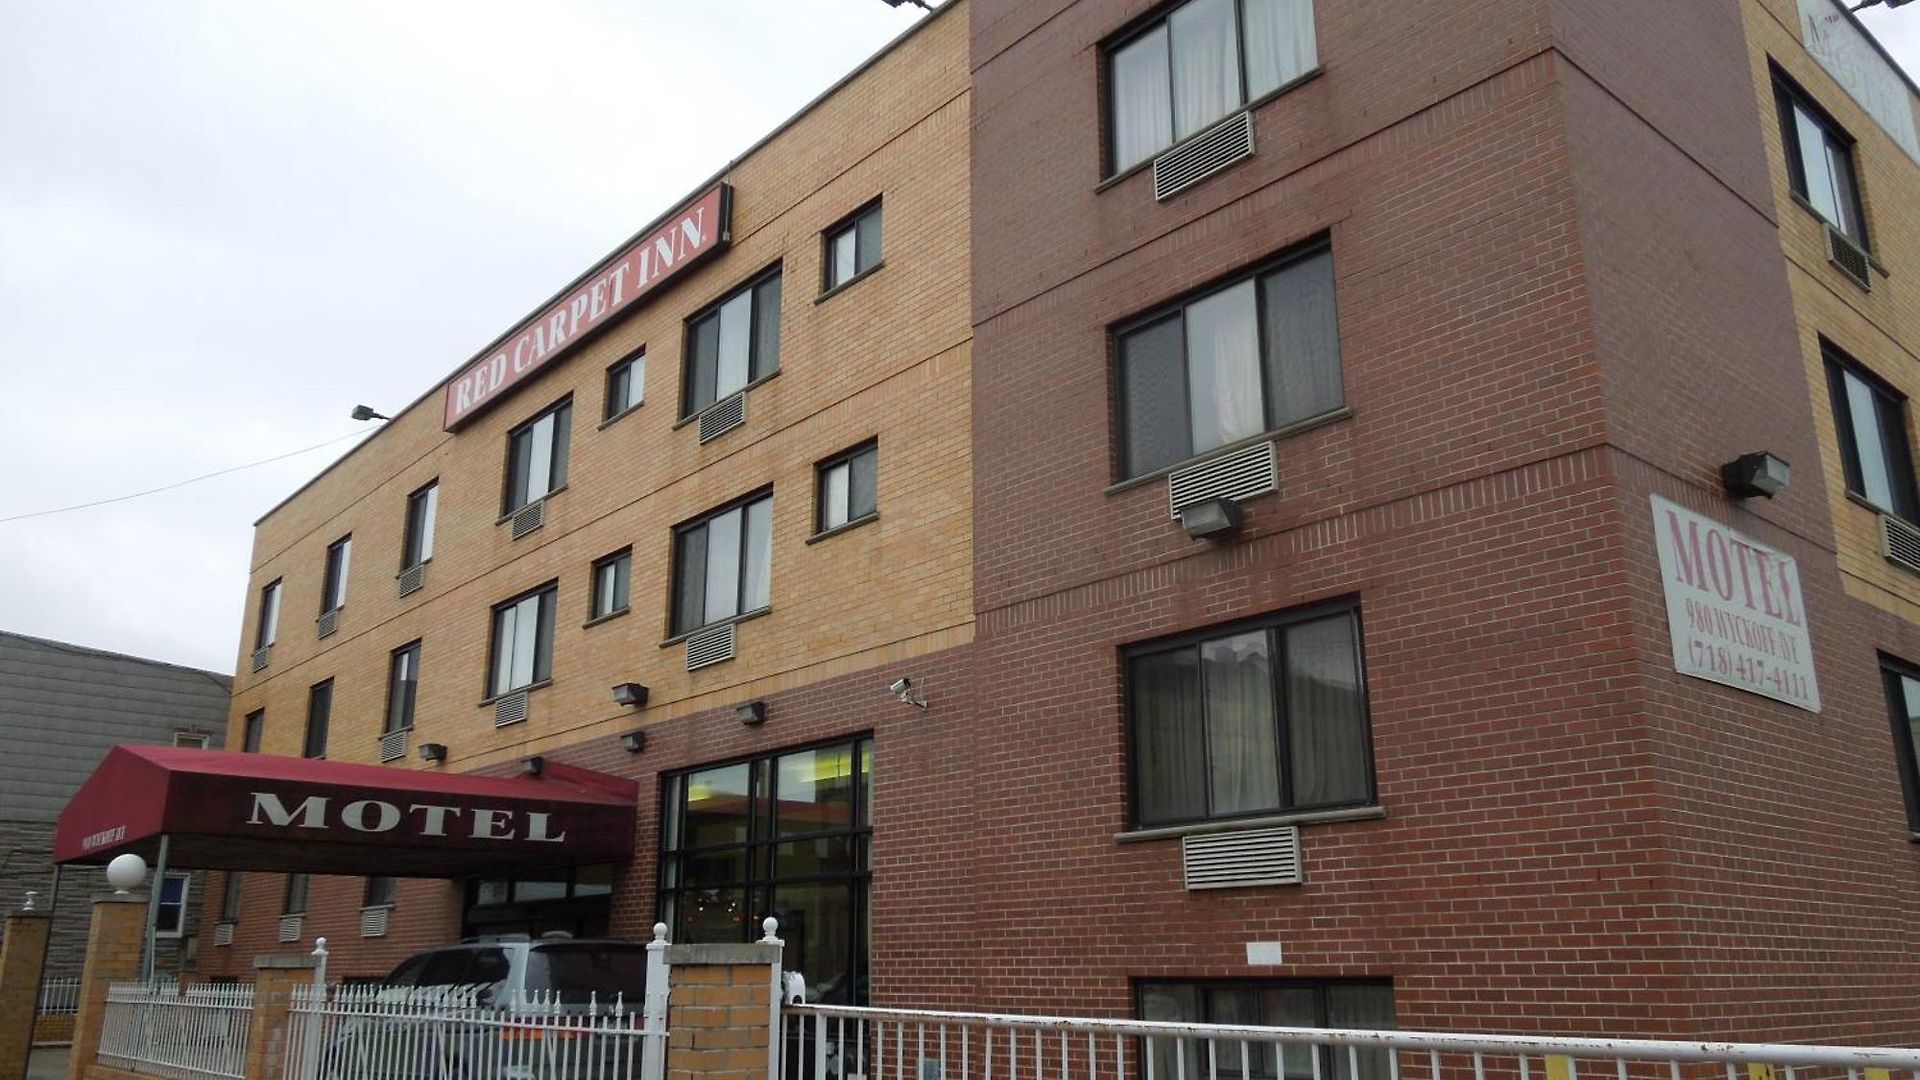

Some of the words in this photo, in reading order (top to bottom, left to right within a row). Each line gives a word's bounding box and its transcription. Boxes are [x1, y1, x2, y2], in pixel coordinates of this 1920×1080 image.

[455, 354, 507, 414] RED
[514, 265, 630, 372] CARPET
[637, 207, 705, 288] INN
[1667, 510, 1801, 626] MOTEL
[1686, 598, 1713, 635] 980
[246, 792, 566, 842] MOTEL
